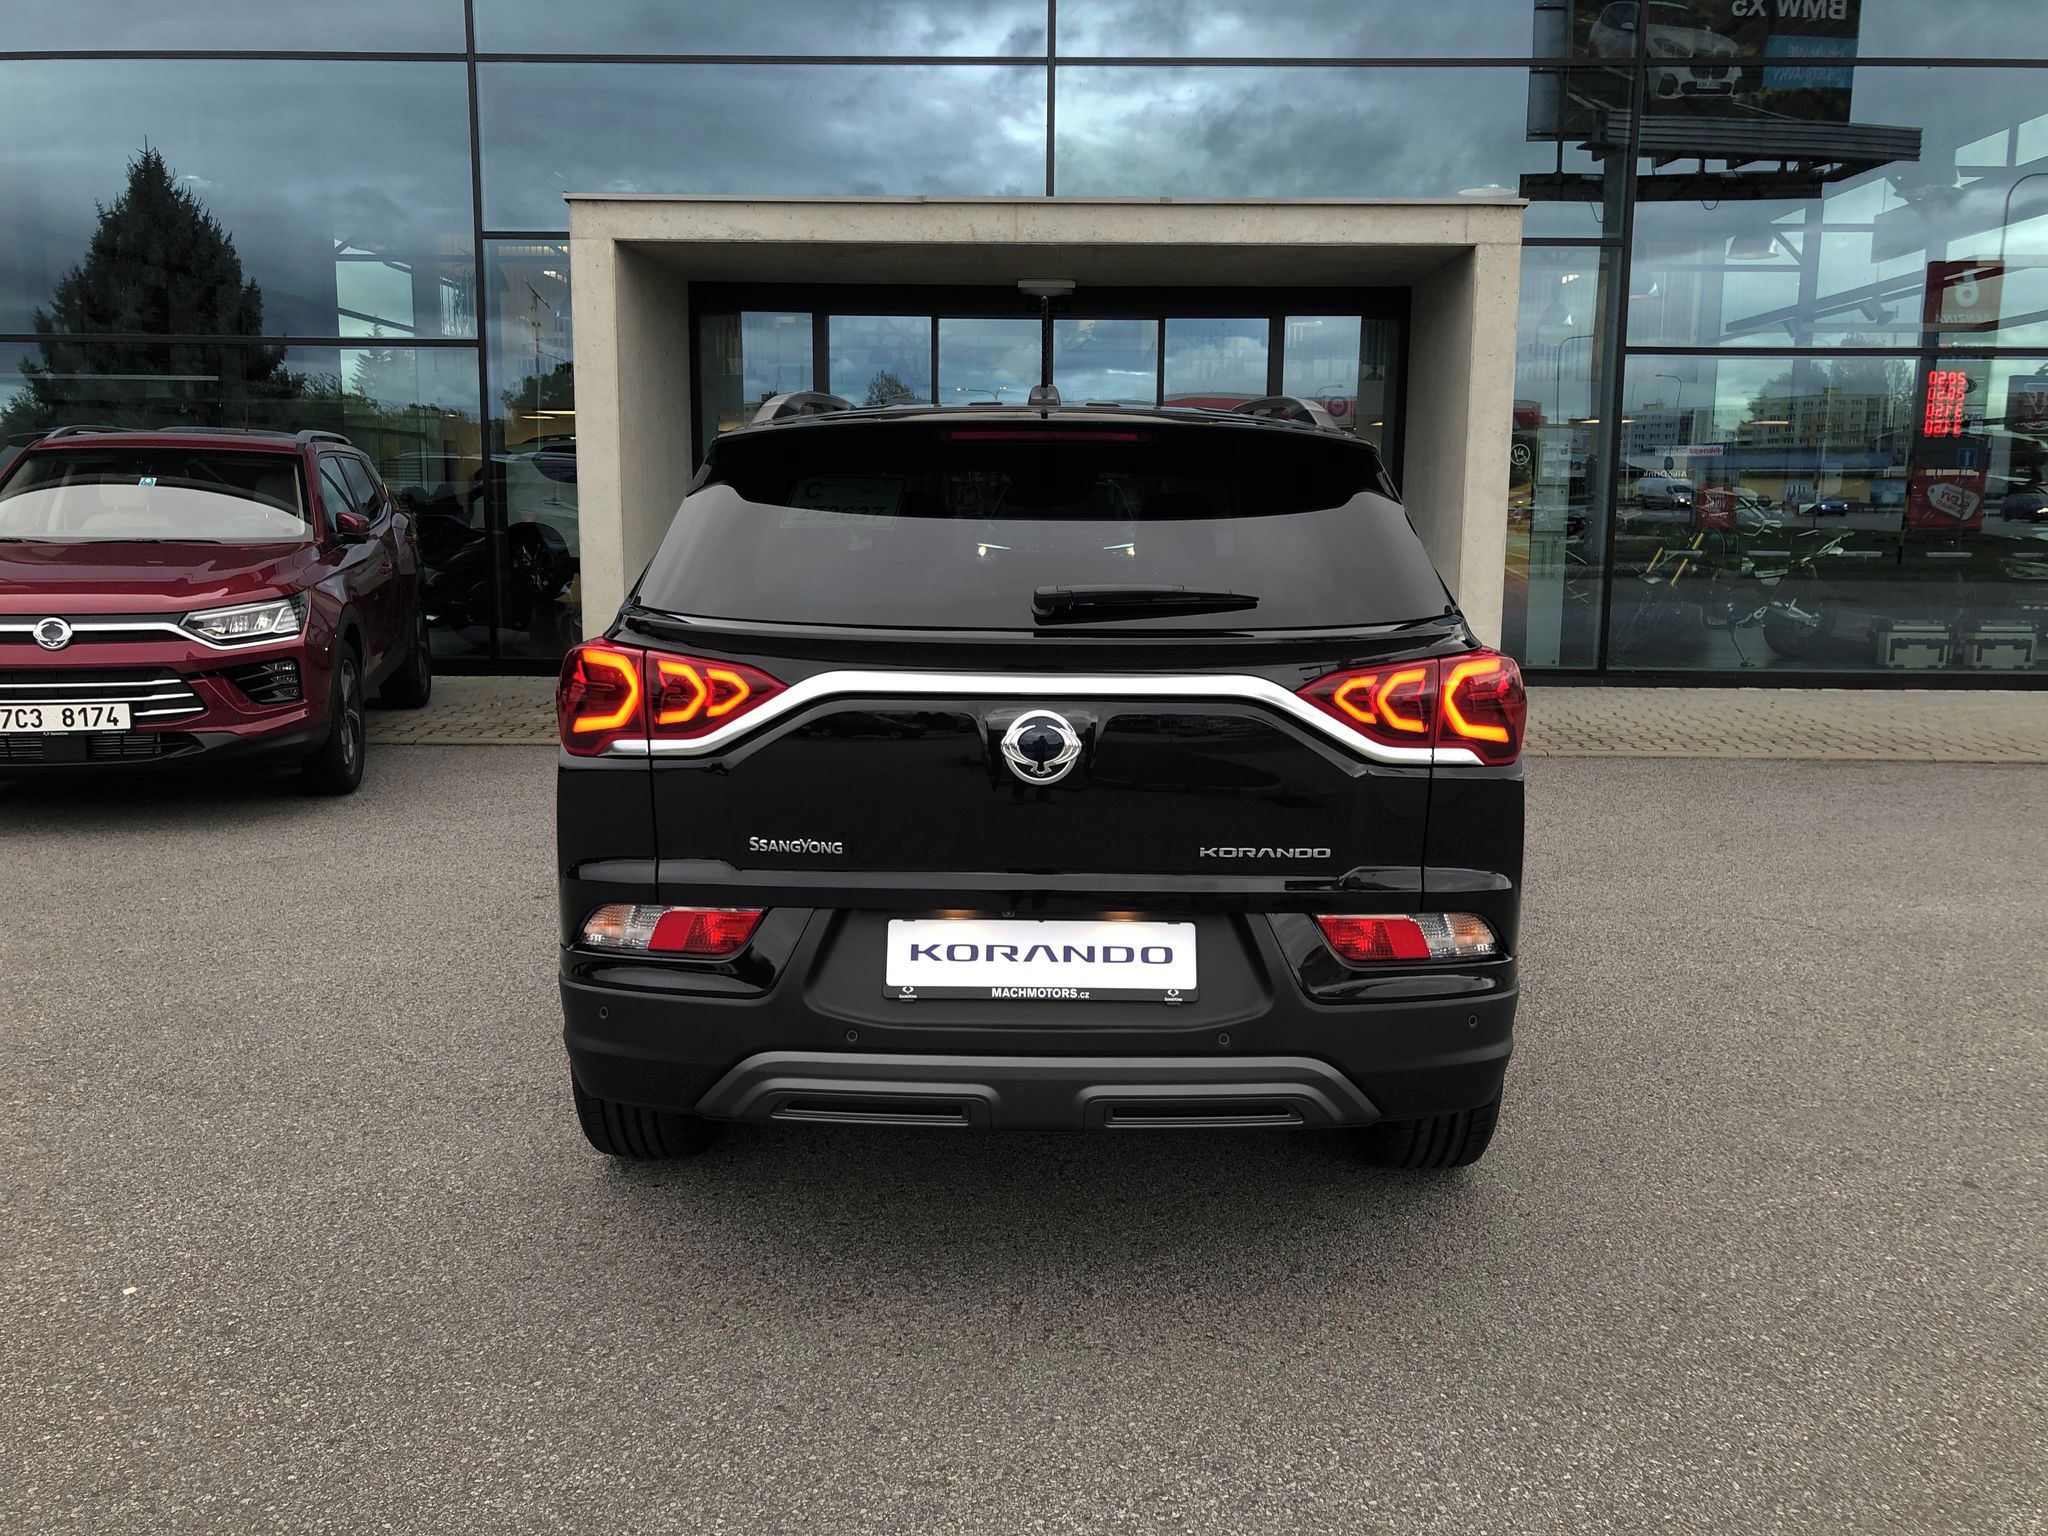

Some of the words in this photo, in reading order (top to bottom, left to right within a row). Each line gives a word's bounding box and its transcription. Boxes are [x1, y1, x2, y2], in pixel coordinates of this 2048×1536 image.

[0, 708, 43, 729] 7C3
[62, 706, 119, 728] 8174
[1199, 847, 1331, 858] KORANDO
[910, 943, 1174, 965] KORANDO
[991, 987, 1090, 999] MACHMOTORS.cz
